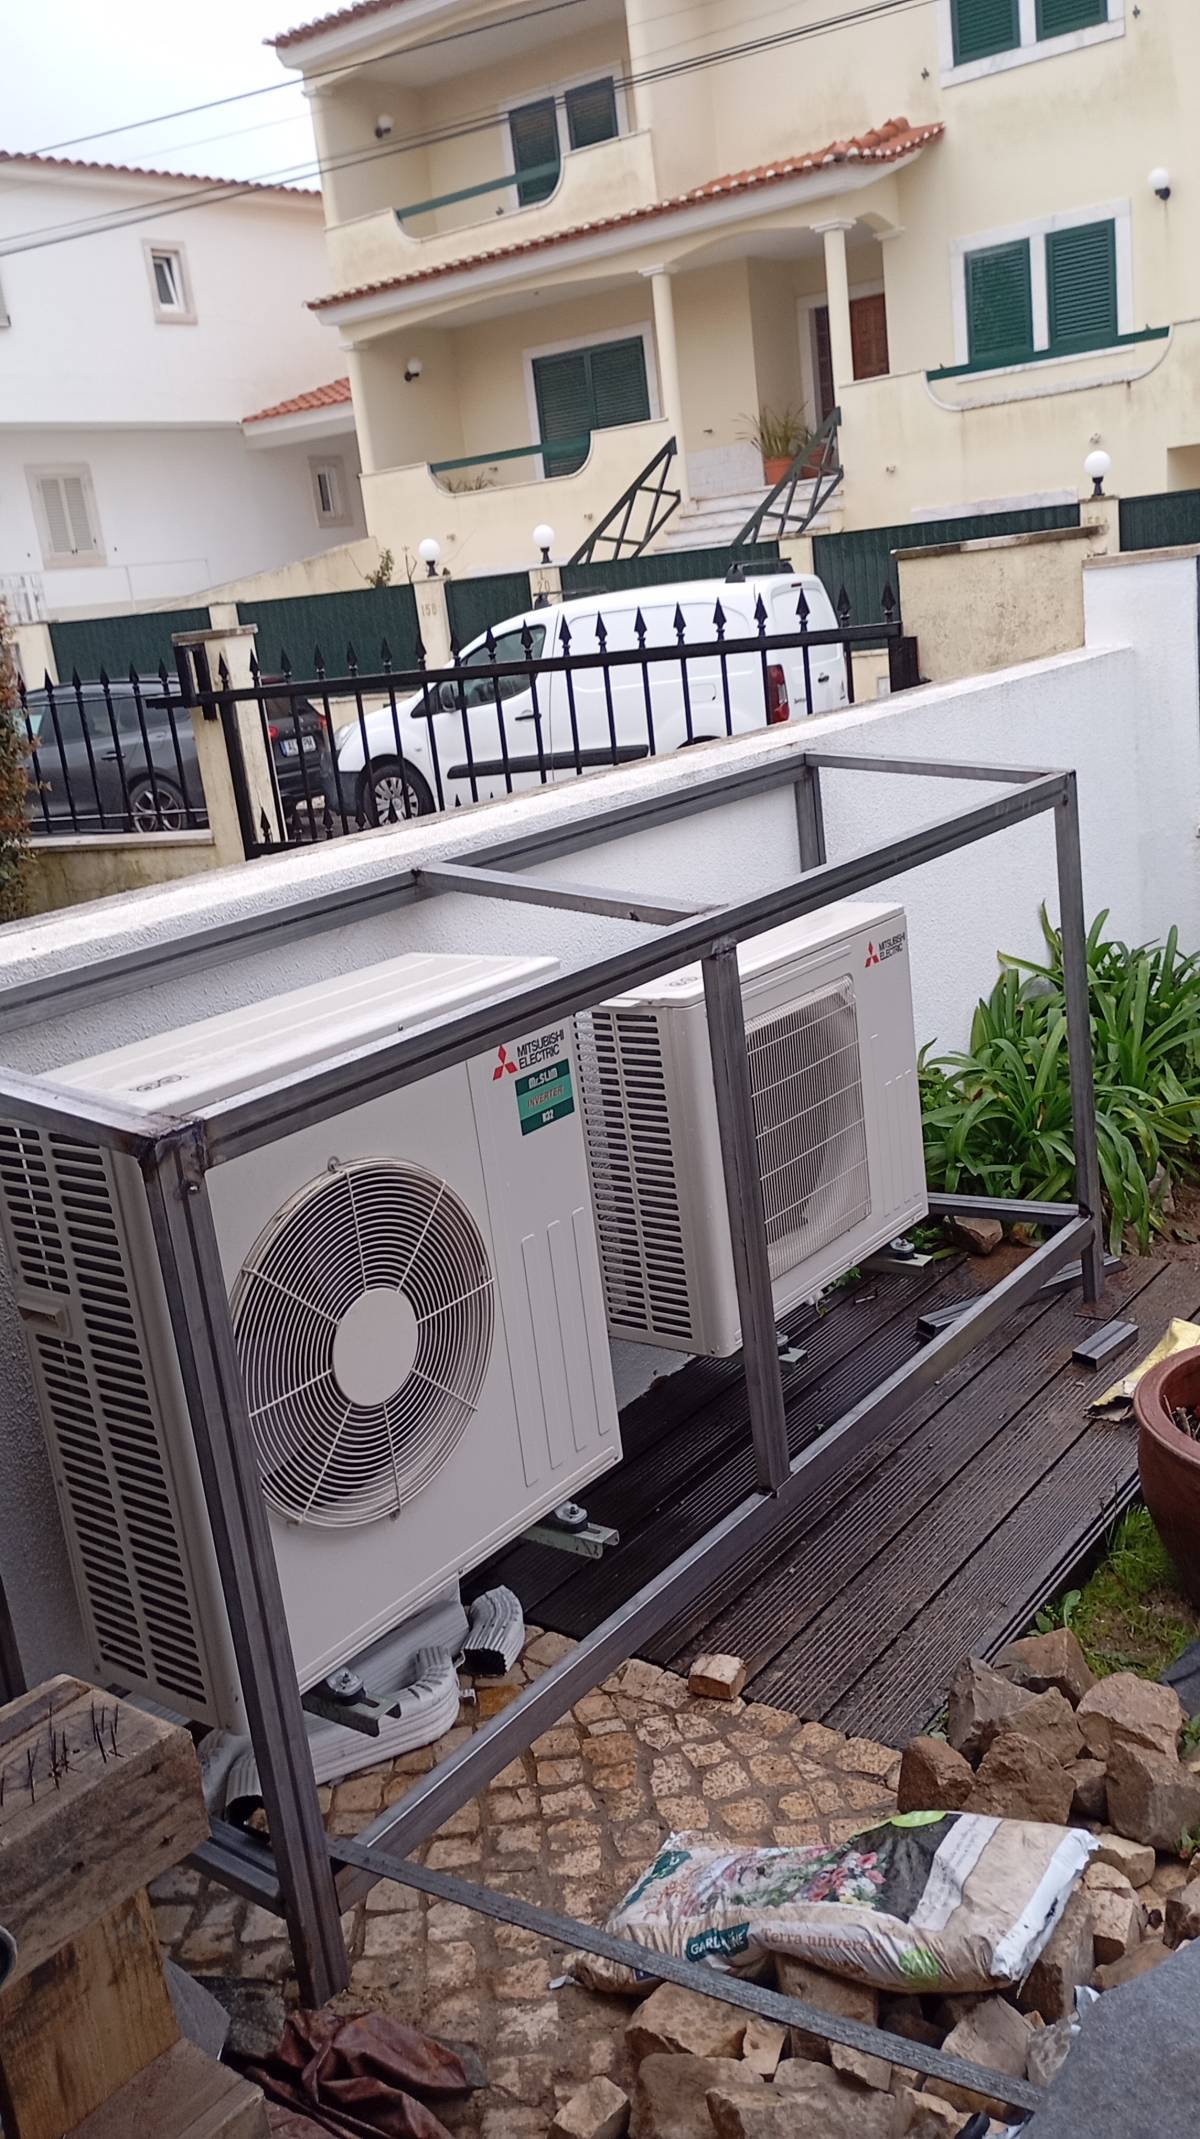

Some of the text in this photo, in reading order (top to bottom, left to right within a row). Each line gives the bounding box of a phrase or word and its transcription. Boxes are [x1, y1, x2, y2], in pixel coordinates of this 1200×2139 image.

[516, 1029, 565, 1057] MITSUBISHI
[518, 1043, 560, 1070] ELECTRIC
[527, 1085, 564, 1108] INVERTER
[761, 1927, 803, 1945] Terra
